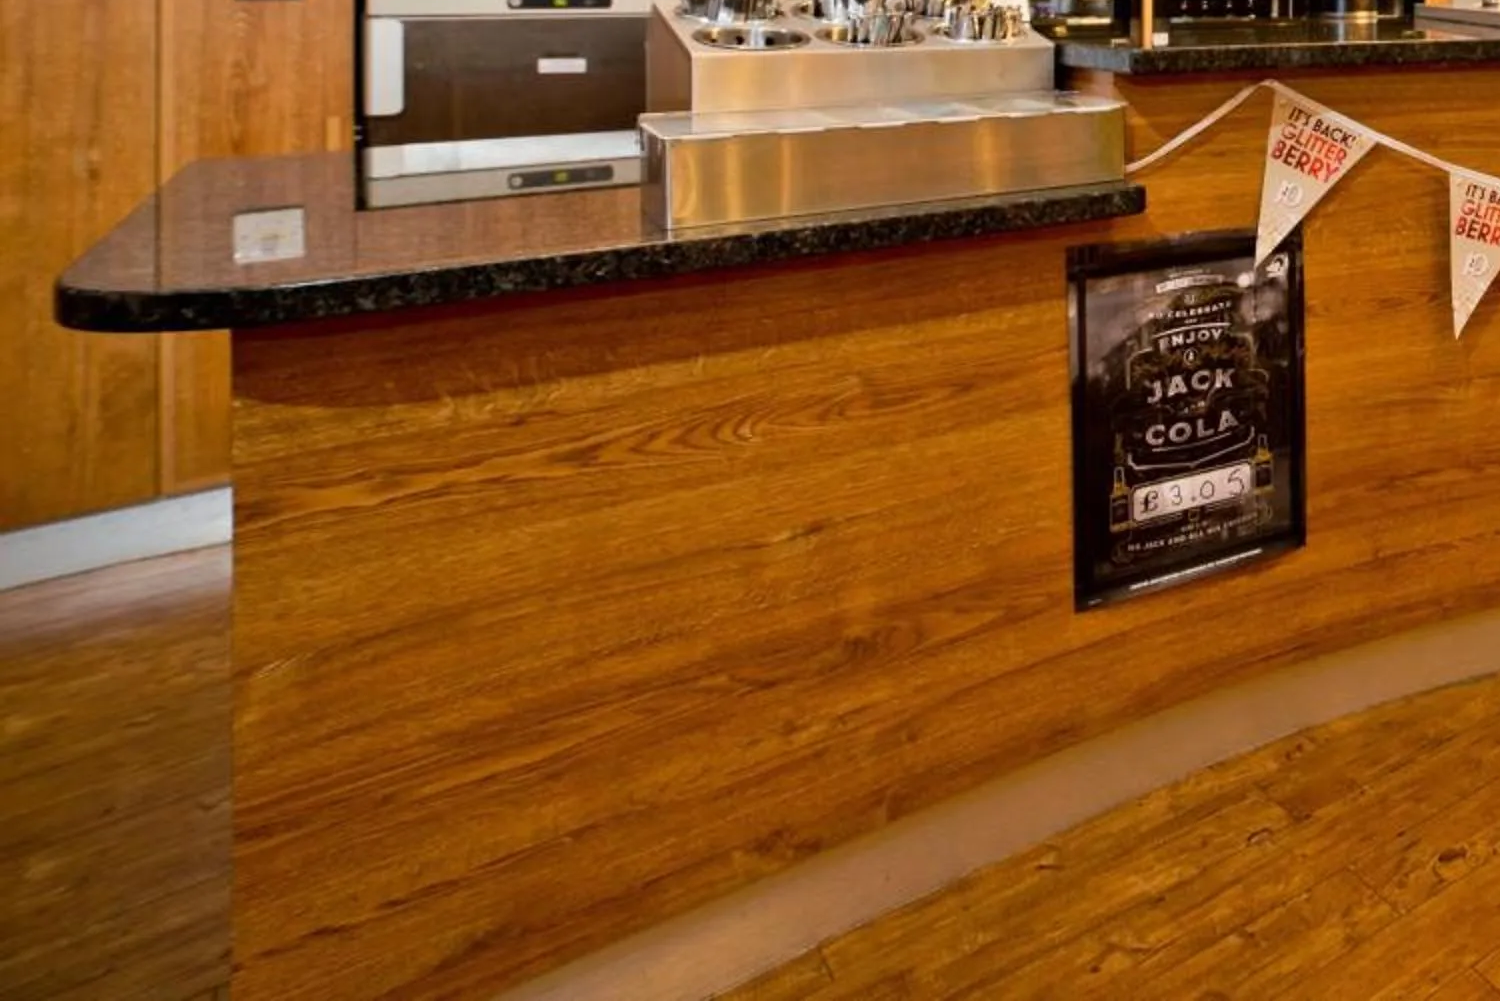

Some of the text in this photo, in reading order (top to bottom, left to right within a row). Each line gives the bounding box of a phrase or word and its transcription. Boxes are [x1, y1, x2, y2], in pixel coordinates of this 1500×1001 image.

[1271, 140, 1340, 183] BERRY
[1281, 122, 1347, 165] GLITTER
[1159, 327, 1223, 352] ENJOY
[1145, 368, 1235, 404] JACK
[1145, 410, 1239, 446] COLA
